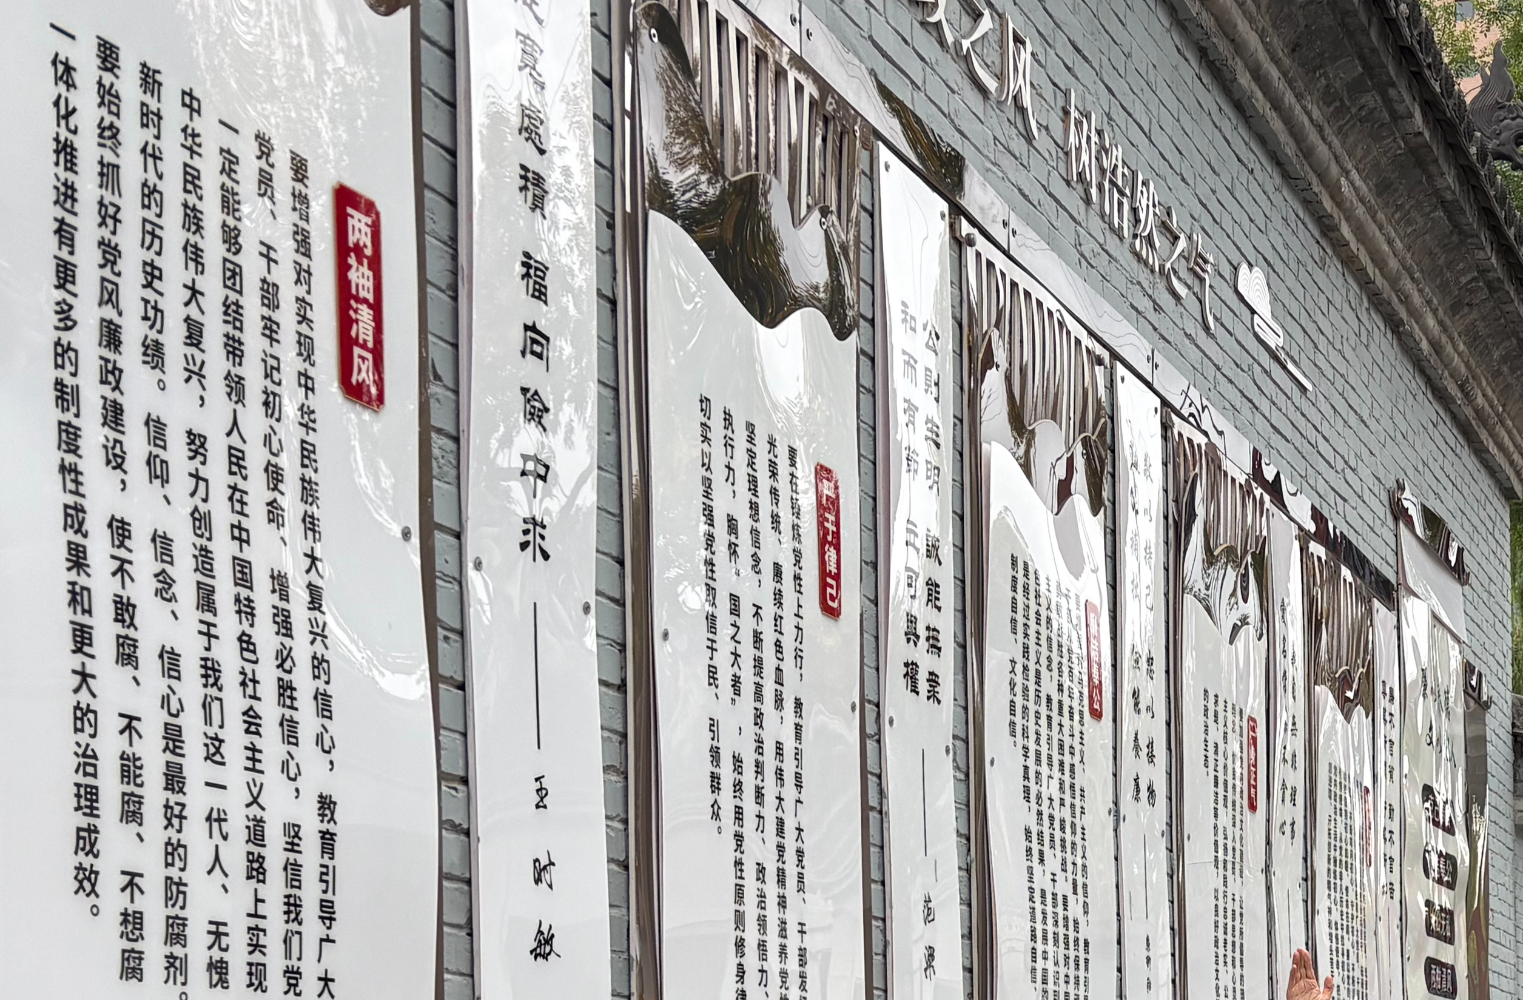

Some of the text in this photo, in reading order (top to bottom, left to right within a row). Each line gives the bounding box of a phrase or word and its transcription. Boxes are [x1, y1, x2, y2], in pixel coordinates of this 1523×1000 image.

[50, 22, 101, 917] 一体化推进有更多的制度性成果和更大的治理成效。
[96, 34, 145, 983] 要始终抓好党风廉政建设，使不敢腐、不能腐、不想腐
[181, 88, 230, 991] 中华民族伟大复兴，努力创造属于我们这一代人、无愧
[218, 118, 268, 994] 一定能够团结带领人民在中国特色社会主义道路上实现
[254, 129, 303, 999] 党员、干部牢记初心使命、增强必胜信心，坚信我们党
[346, 206, 376, 395] 两袖清风
